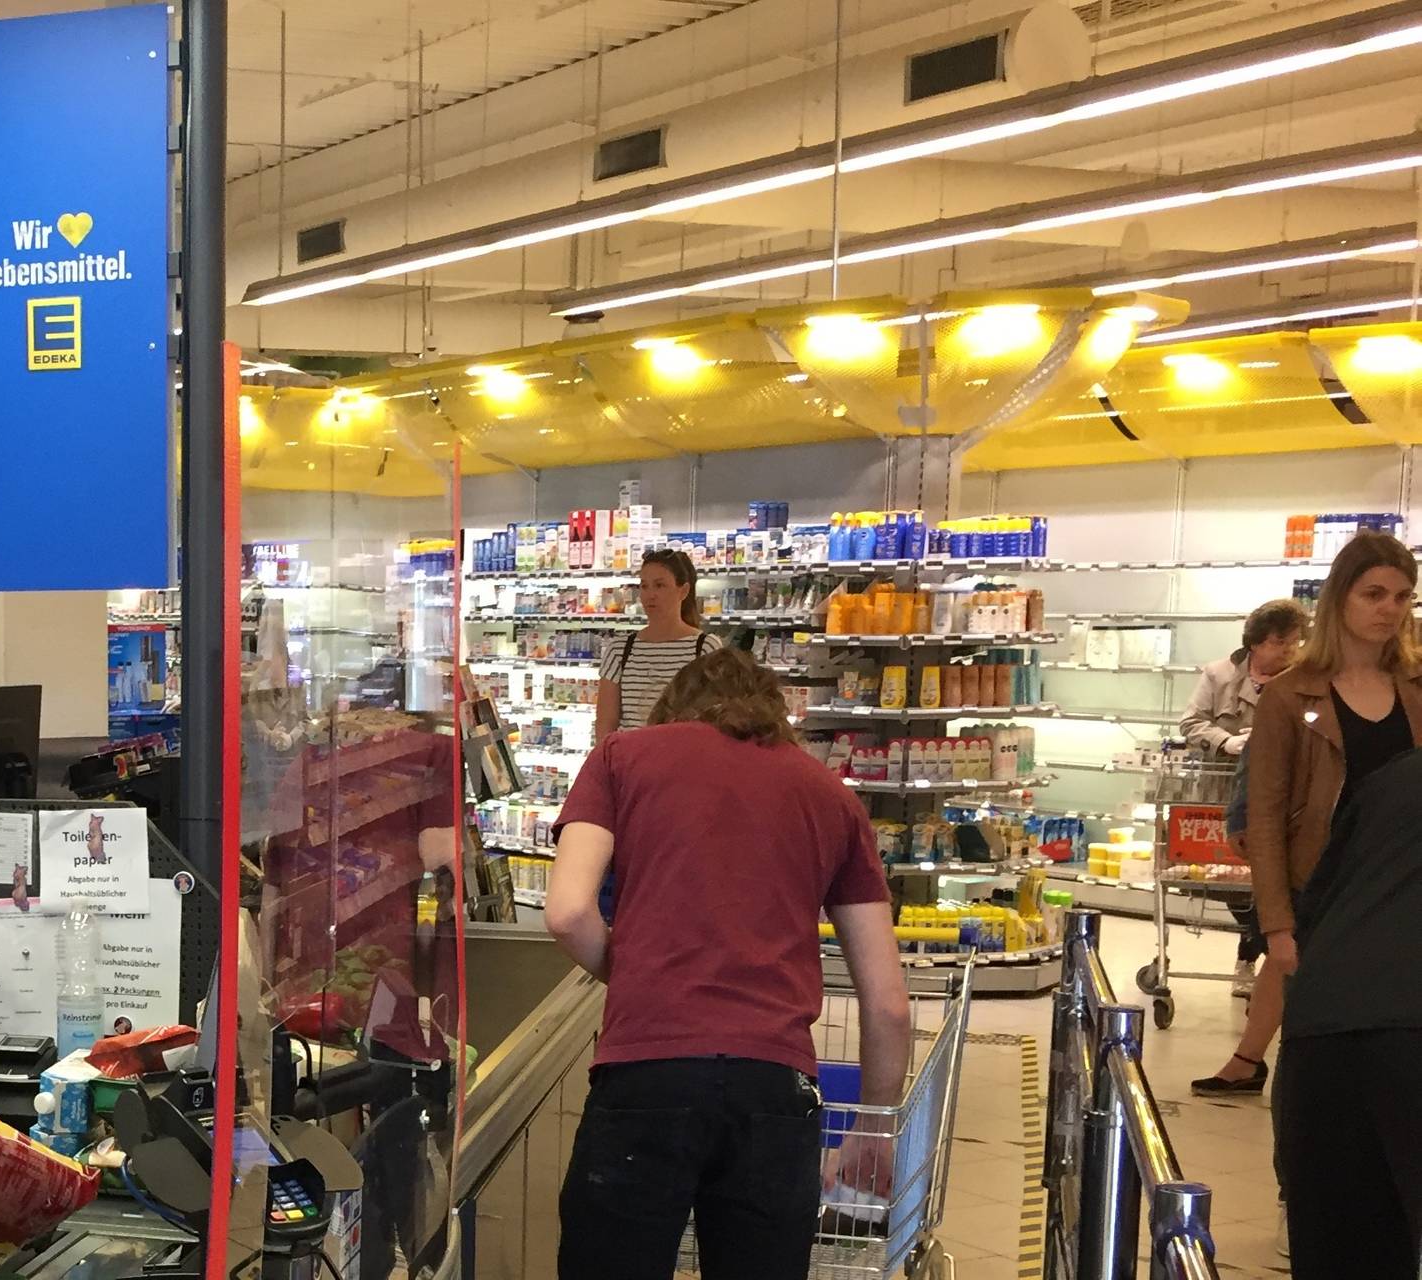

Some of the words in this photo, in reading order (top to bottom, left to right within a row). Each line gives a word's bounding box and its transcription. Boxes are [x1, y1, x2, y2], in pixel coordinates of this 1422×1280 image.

[12, 219, 53, 250] Wir
[33, 354, 77, 364] EDEKA
[62, 830, 122, 842] Toileen-
[67, 875, 96, 885] Abgabe
[84, 903, 107, 912] enge
[146, 945, 153, 953] in
[114, 971, 140, 982] Menge
[113, 985, 119, 994] 2
[120, 986, 161, 997] Packungen
[106, 1001, 119, 1010] pro
[120, 1001, 148, 1010] Einkauf
